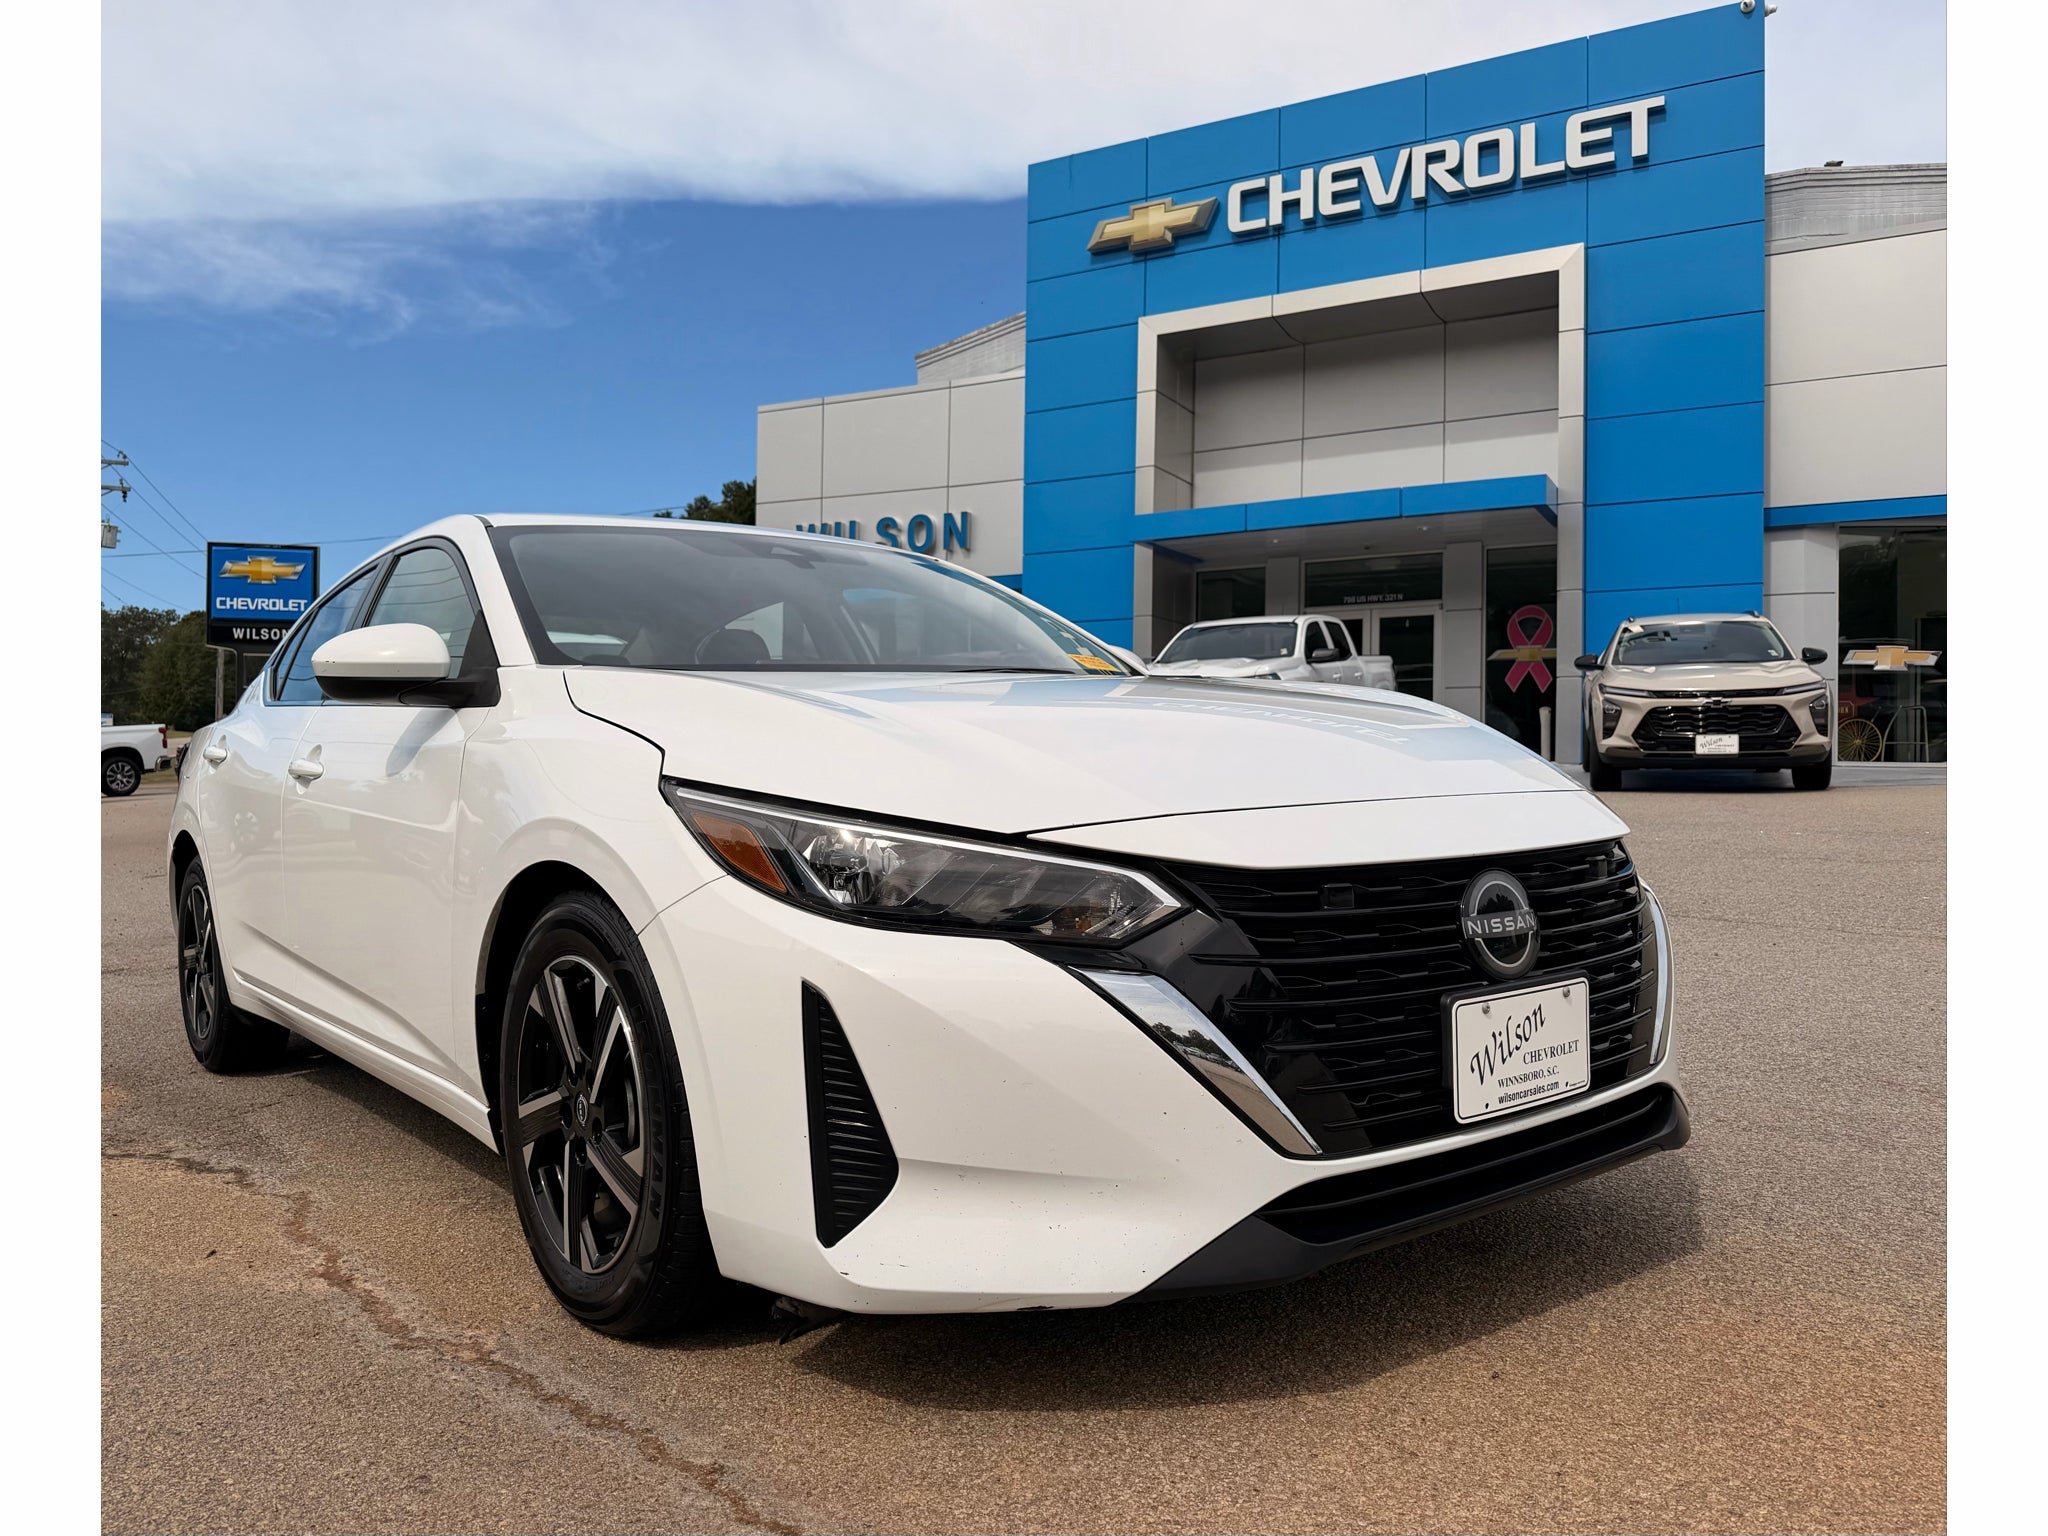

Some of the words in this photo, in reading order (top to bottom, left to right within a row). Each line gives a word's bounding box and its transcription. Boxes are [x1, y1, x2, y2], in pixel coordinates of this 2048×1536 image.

[1228, 95, 1665, 234] CHEVROLET
[216, 597, 307, 611] CHEVROLET
[1467, 912, 1536, 935] NISSAN
[1470, 1003, 1546, 1086] Wilson
[1523, 1039, 1580, 1065] CHEVROLET
[1498, 1070, 1546, 1089] WINNSBORO,
[1546, 1065, 1560, 1076] S.C.
[1498, 1080, 1560, 1105] wilsoncarsales.com
